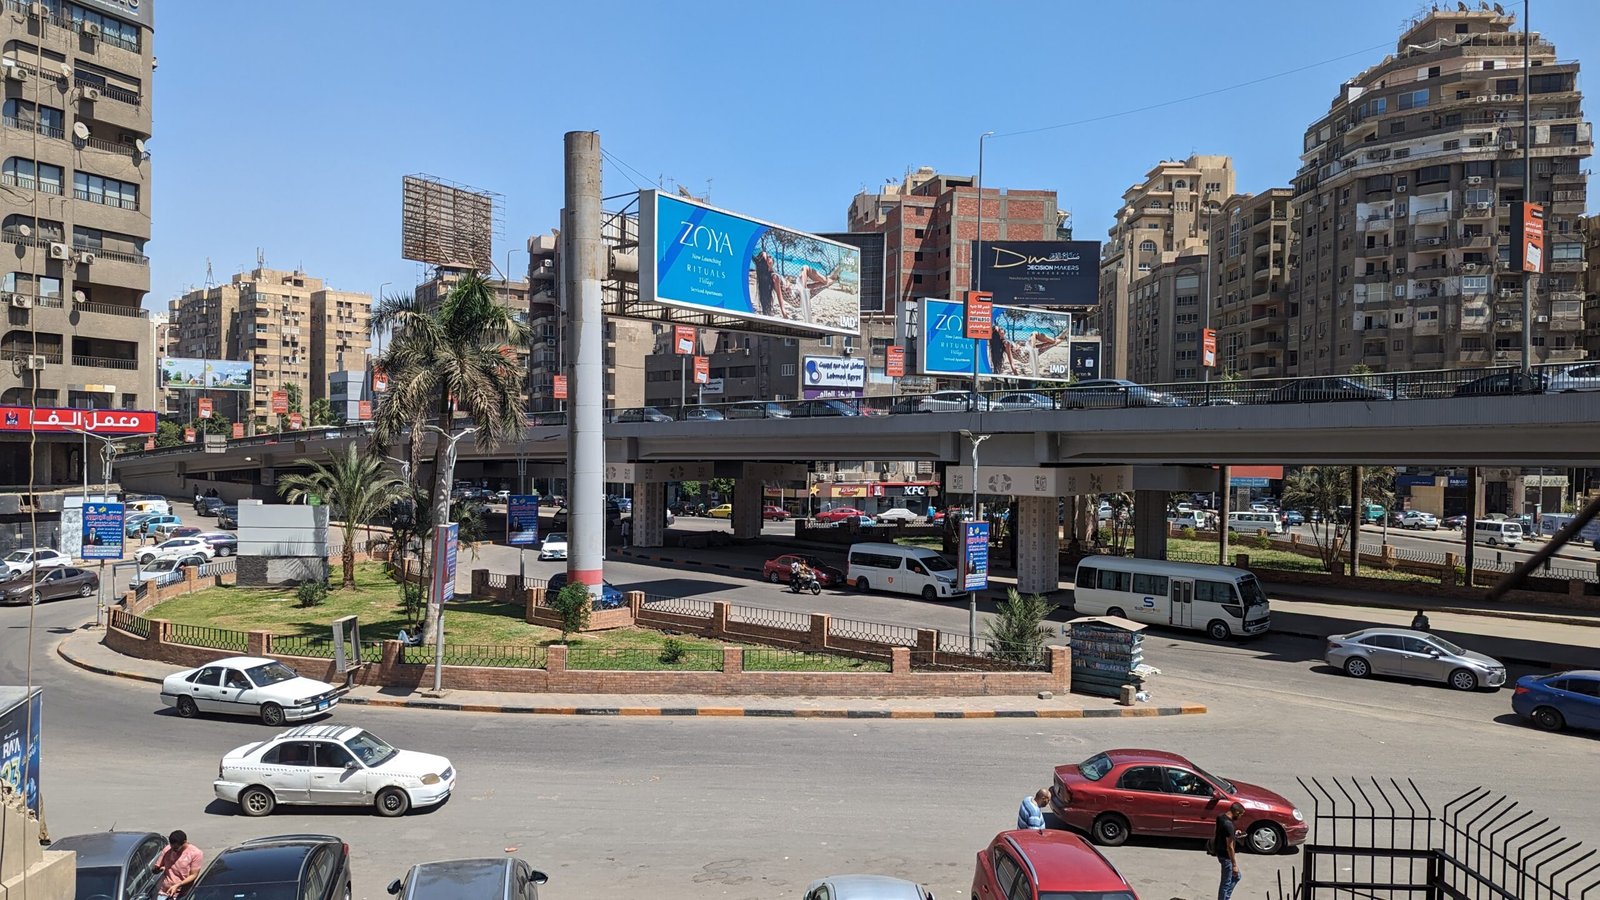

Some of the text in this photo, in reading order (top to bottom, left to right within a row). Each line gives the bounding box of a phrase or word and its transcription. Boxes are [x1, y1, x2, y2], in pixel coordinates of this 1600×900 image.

[680, 220, 733, 256] ZOYA
[686, 263, 726, 279] RITUALS
[935, 313, 963, 332] ZO
[940, 341, 974, 350] RITUALS
[1049, 364, 1065, 373] LMD
[826, 372, 847, 380] Labmed
[29, 410, 140, 429] معمل الفا
[903, 486, 925, 495] KFC
